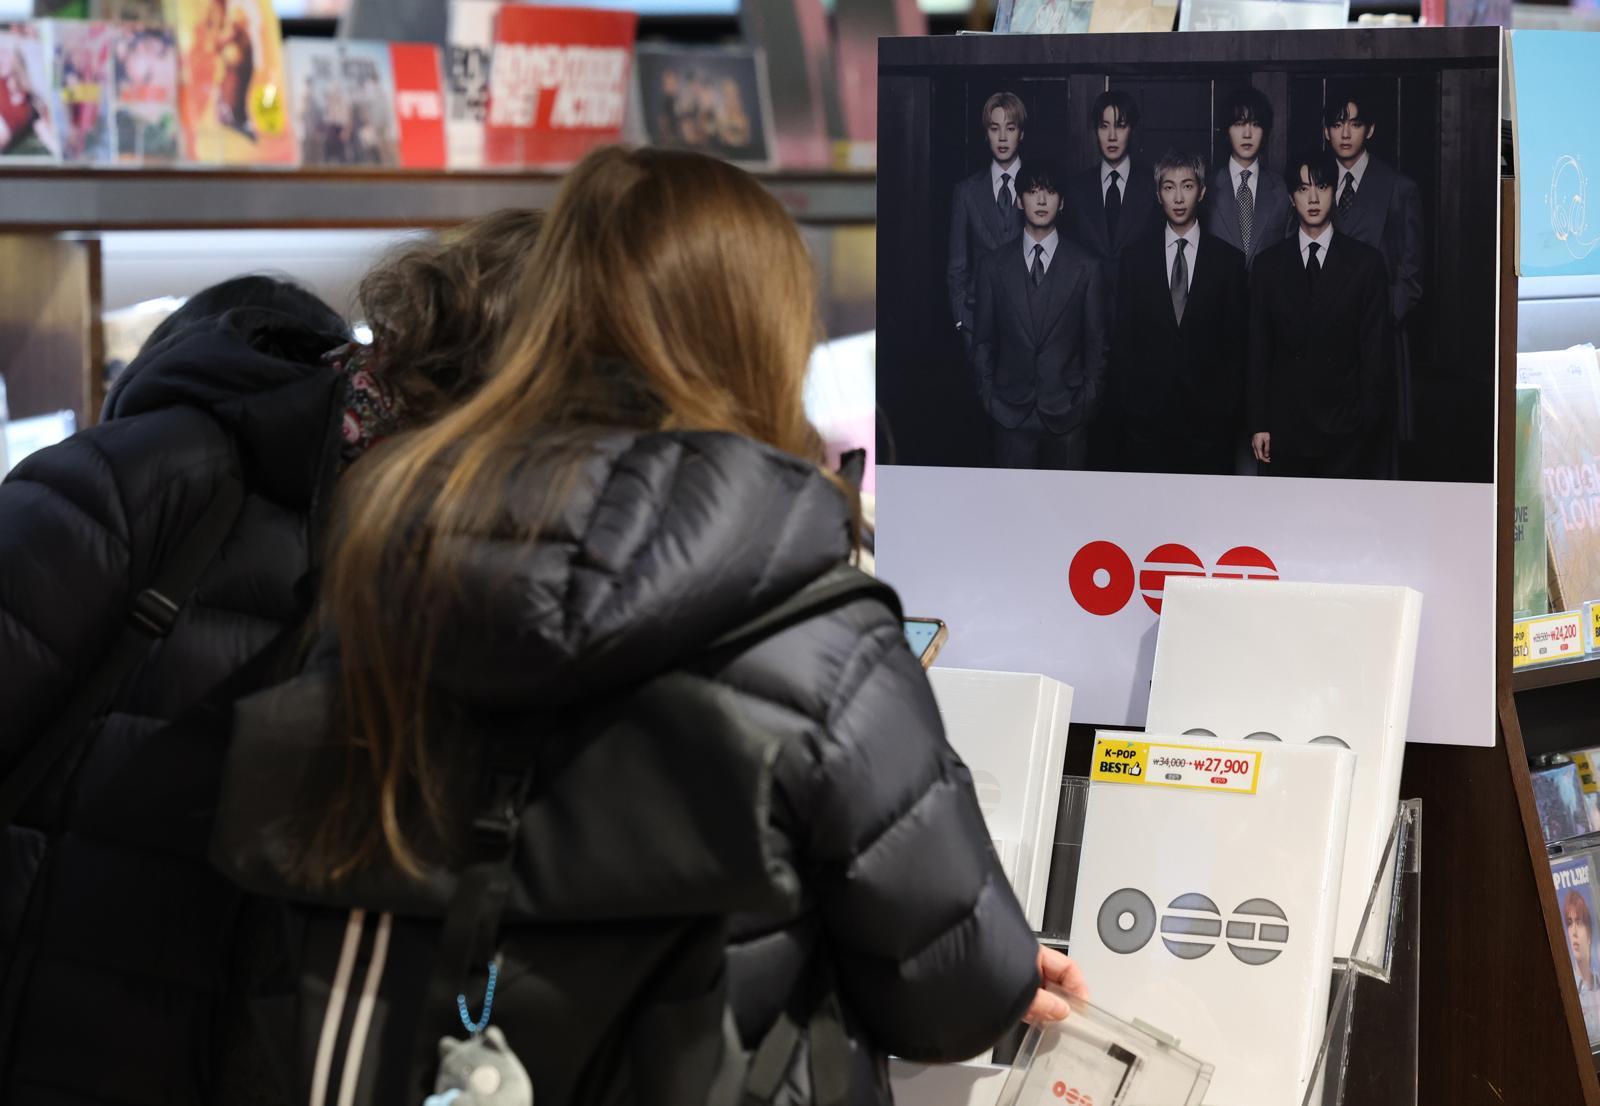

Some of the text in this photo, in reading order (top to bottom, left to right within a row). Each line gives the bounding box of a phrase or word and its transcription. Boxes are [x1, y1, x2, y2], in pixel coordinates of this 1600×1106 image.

[1104, 748, 1137, 761] K-POP
[1099, 761, 1130, 774] BEST
[1193, 757, 1249, 775] ₩27,900
